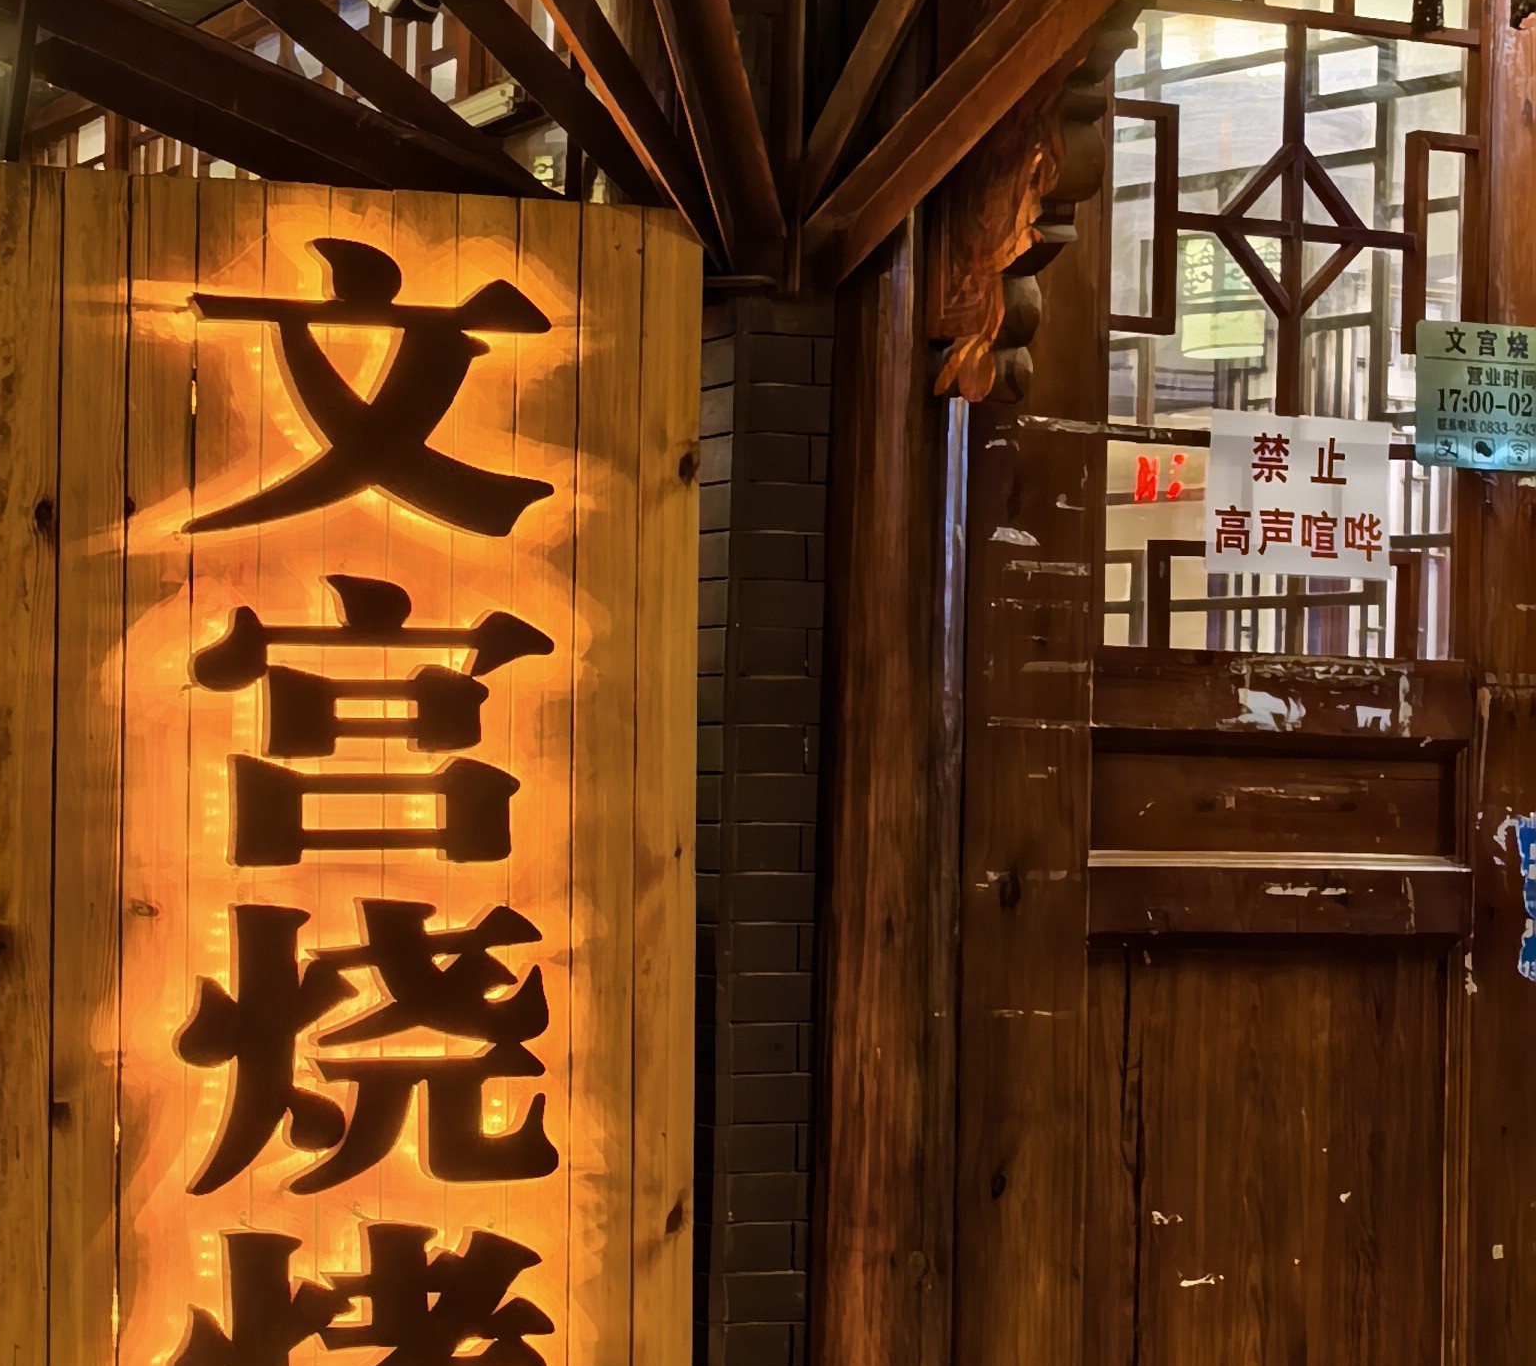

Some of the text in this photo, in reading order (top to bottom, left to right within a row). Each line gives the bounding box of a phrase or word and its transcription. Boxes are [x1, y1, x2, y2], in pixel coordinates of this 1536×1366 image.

[1467, 366, 1536, 390] 营业时间
[1252, 432, 1347, 485] 禁止
[1215, 505, 1383, 562] 高声喧哗
